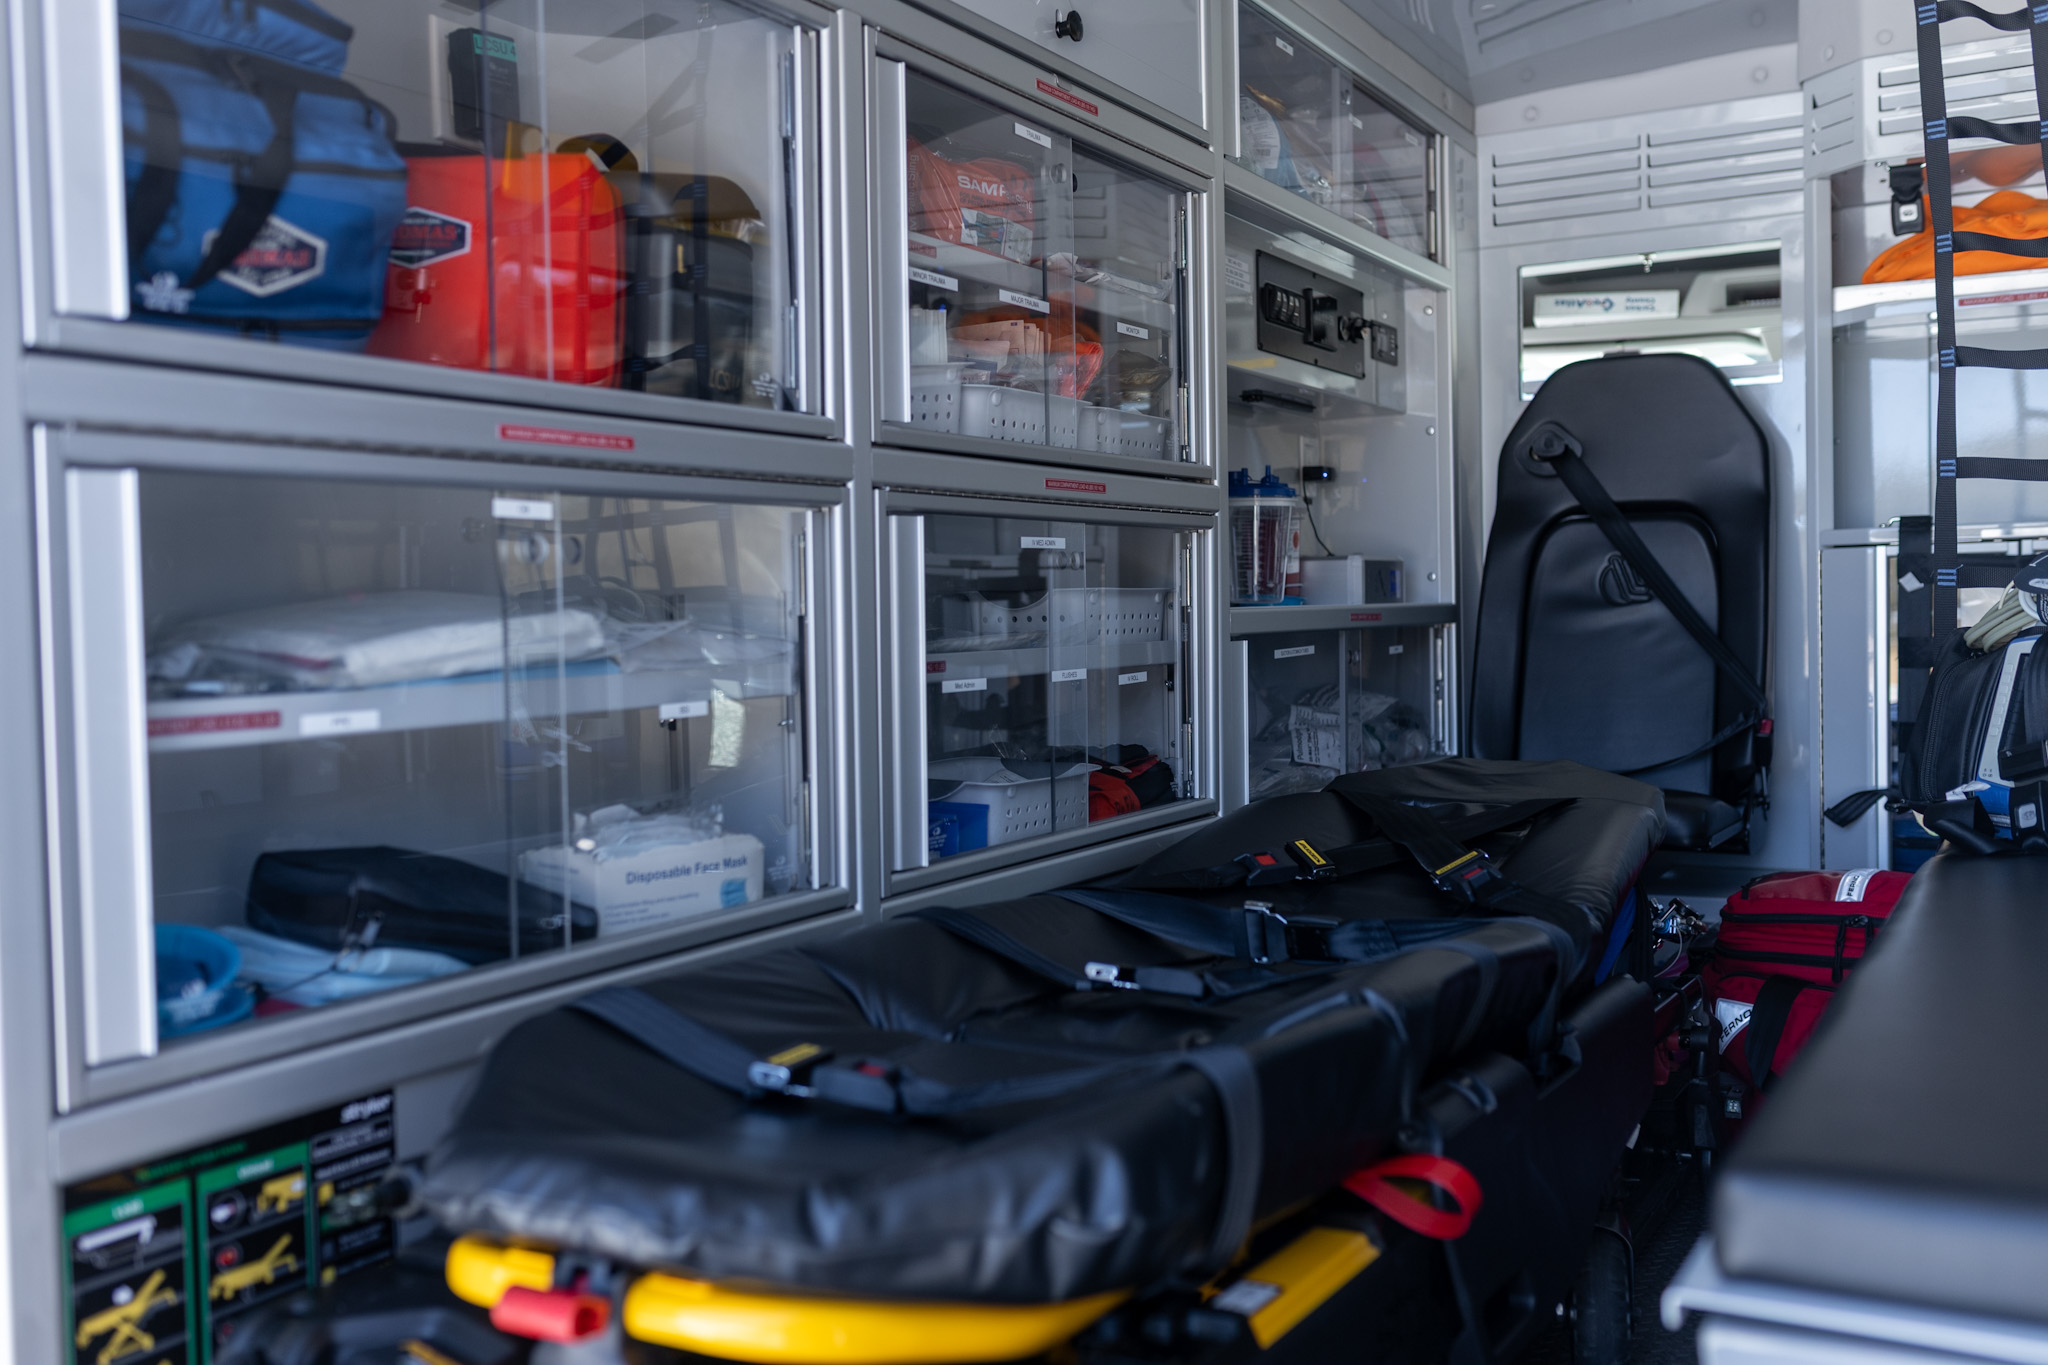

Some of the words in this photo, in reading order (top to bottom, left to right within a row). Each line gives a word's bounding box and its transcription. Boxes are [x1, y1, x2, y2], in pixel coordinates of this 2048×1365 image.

[1026, 130, 1041, 142] TRAUMA
[957, 175, 998, 197] SAM
[912, 271, 927, 281] MINOR
[928, 274, 946, 285] TRAUMA
[1011, 295, 1024, 304] MAJOR
[1024, 298, 1040, 308] TRAUMA
[1062, 671, 1078, 679] FLUSHES
[626, 864, 692, 885] Disposable
[694, 860, 720, 875] Face
[722, 855, 748, 871] Mask
[1720, 1009, 1752, 1043] FERNO
